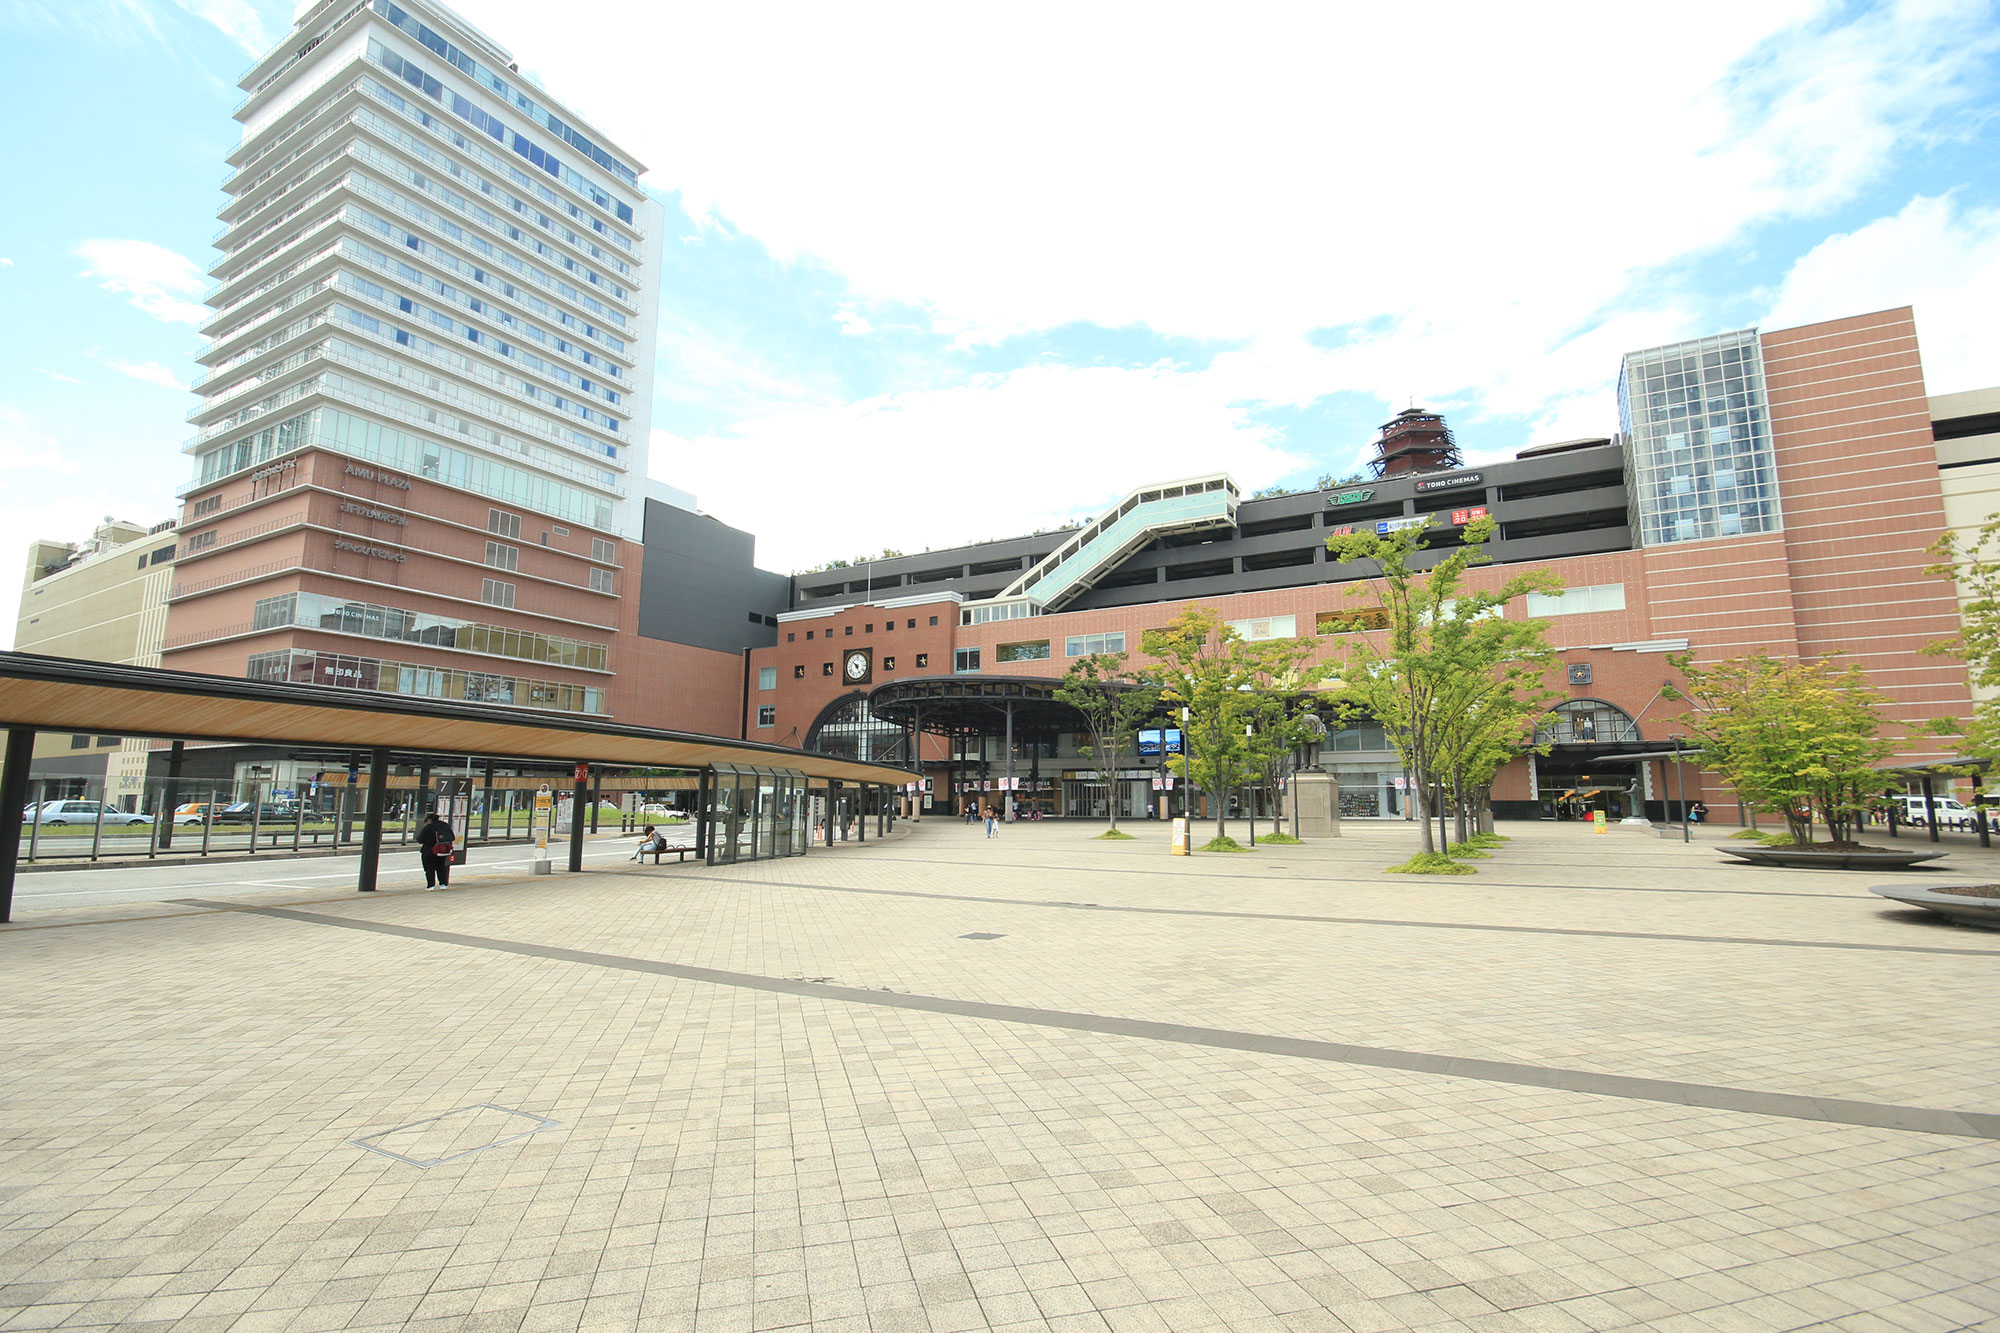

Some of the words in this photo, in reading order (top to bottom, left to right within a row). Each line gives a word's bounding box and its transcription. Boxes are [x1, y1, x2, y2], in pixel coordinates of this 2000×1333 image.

[345, 464, 375, 480] AMU
[377, 471, 412, 491] PLAZA
[1427, 480, 1446, 489] TOHO
[1447, 475, 1480, 486] CINEMAS
[351, 611, 380, 622] CINMAS
[441, 780, 449, 792] 7
[459, 780, 467, 792] 7
